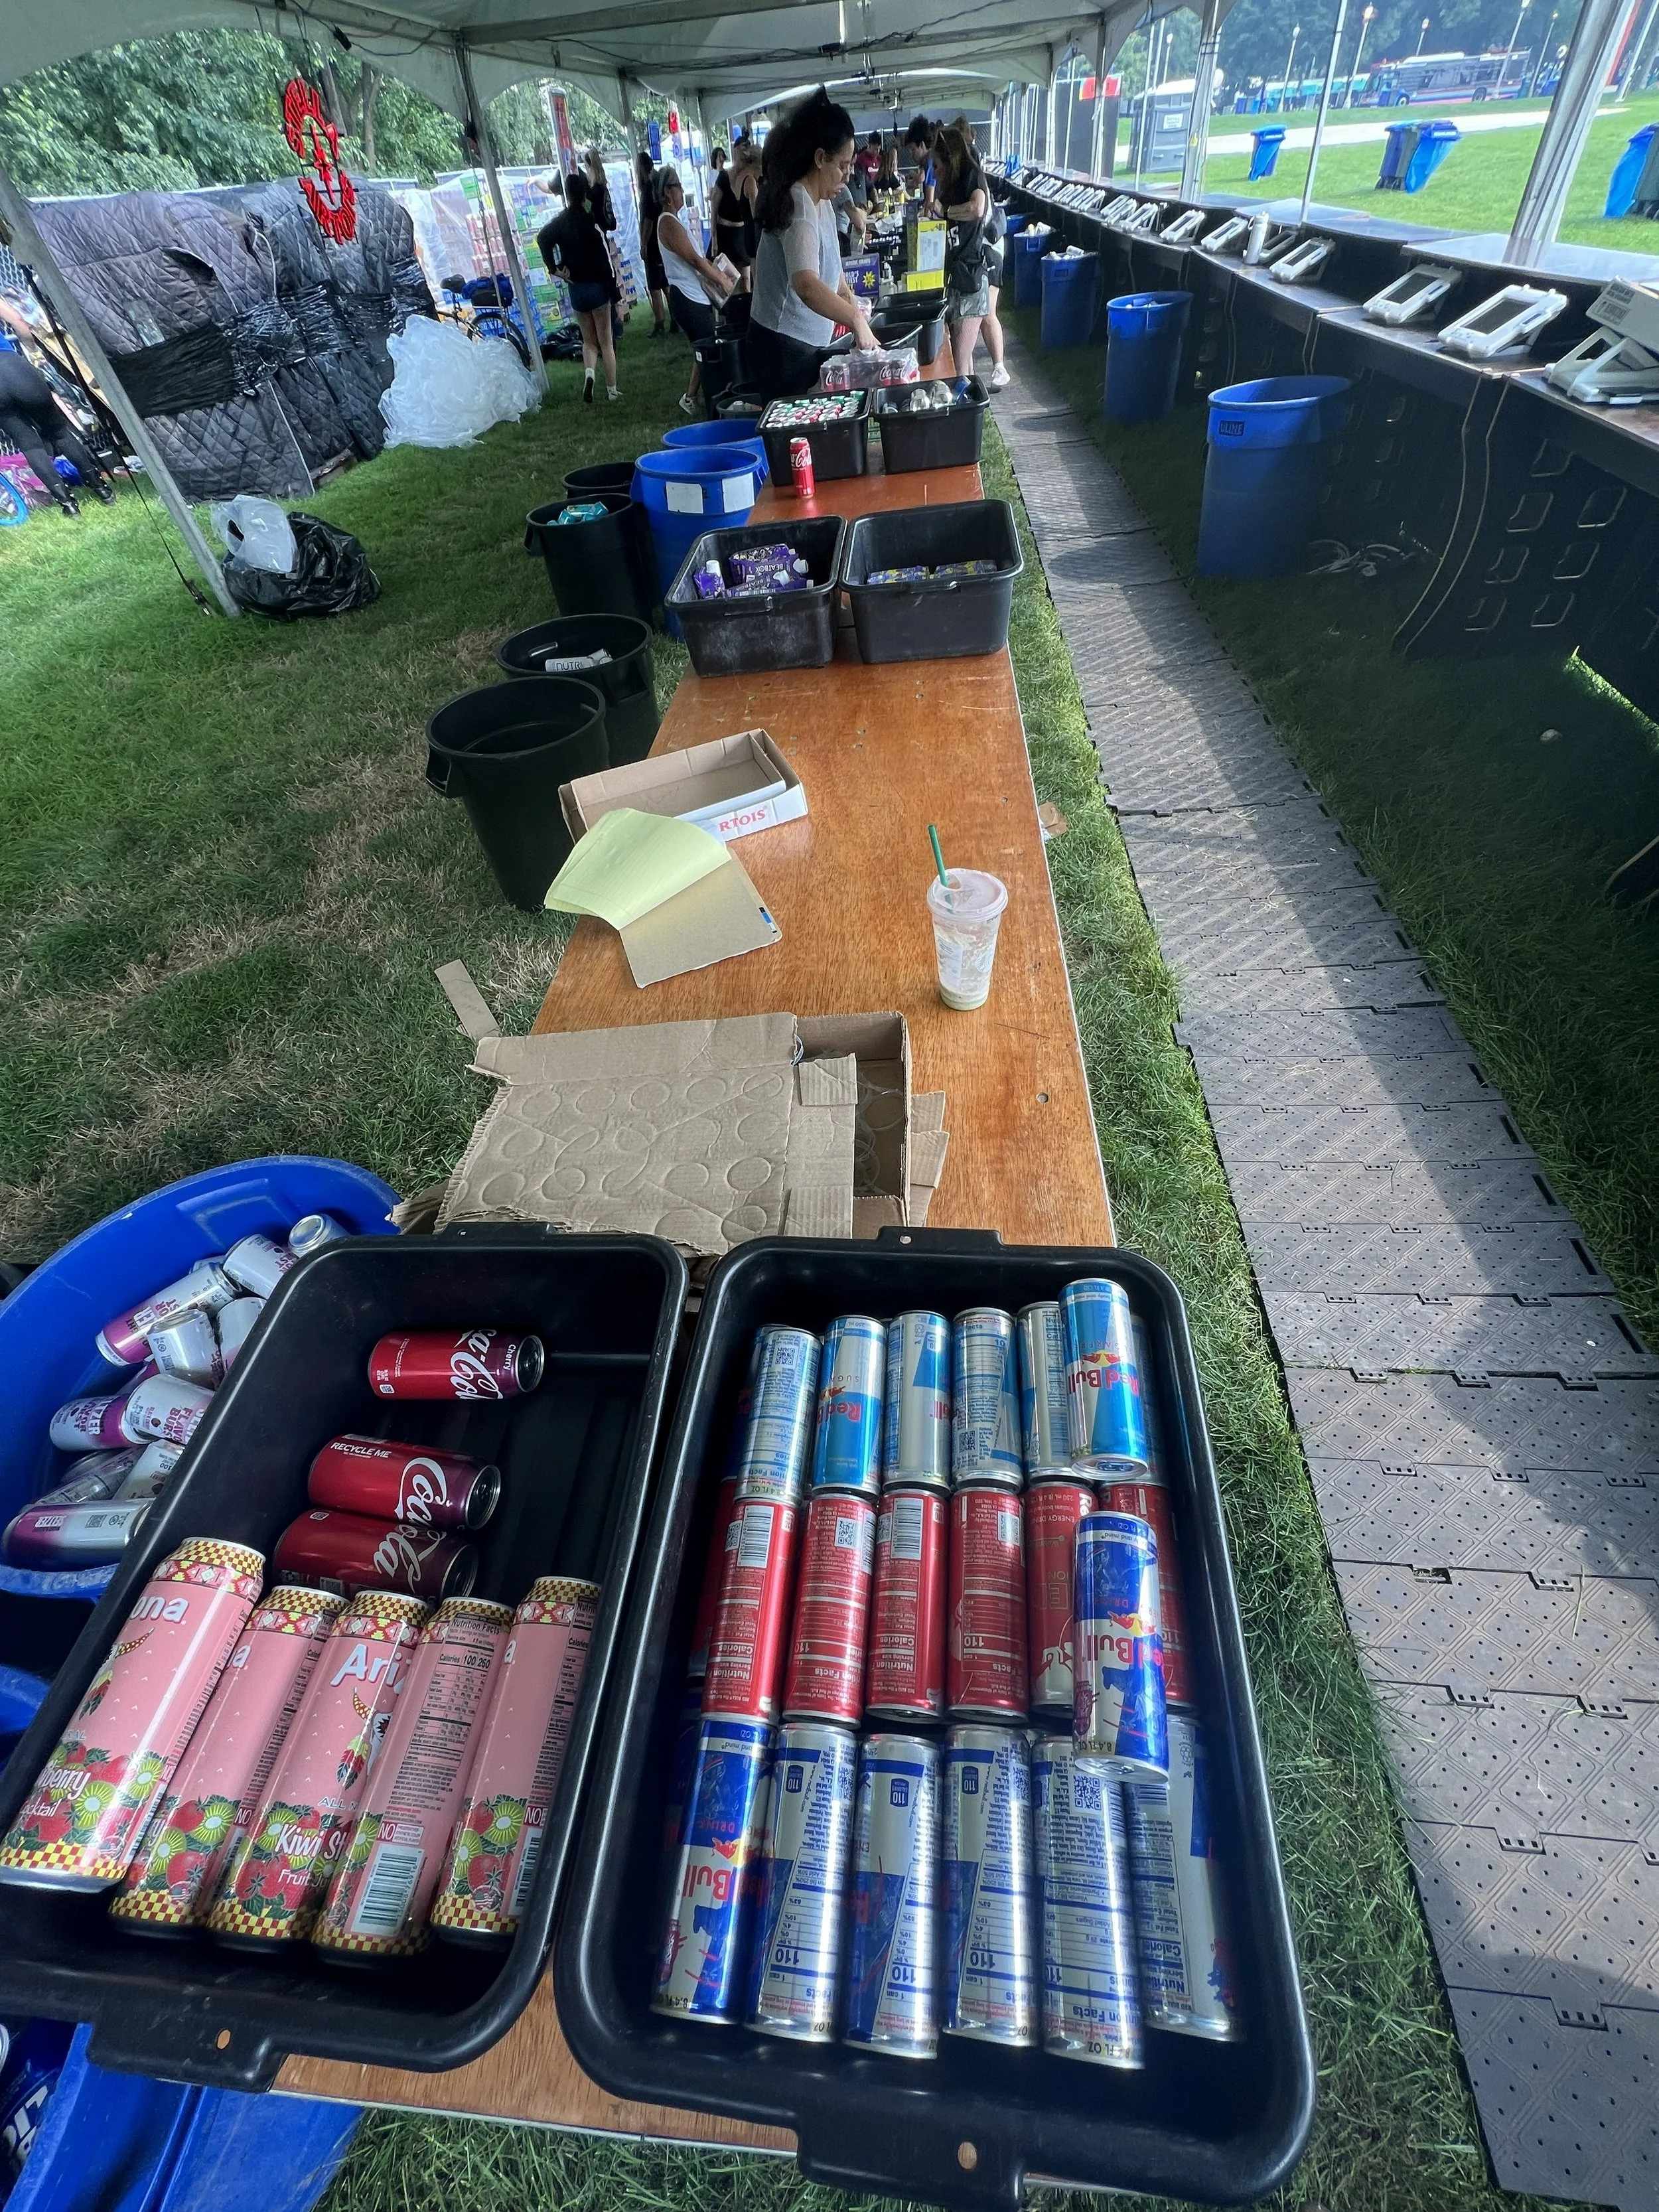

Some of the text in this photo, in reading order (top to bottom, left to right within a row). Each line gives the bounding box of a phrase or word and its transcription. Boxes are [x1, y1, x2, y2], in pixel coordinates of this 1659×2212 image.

[1220, 421, 1243, 435] ULINE
[755, 563, 784, 573] BEATBOX
[718, 810, 766, 832] RTOIS
[503, 1344, 516, 1370] Cherry
[1068, 1370, 1140, 1396] Red Bull
[827, 1401, 861, 1422] Red
[162, 1407, 178, 1439] BURS
[330, 1442, 375, 1456] RECYCLE
[374, 1450, 392, 1459] ME
[452, 1619, 500, 1635] Nutrition Facts
[880, 1636, 914, 1646] Calories
[964, 1636, 984, 1647] 110
[719, 1644, 753, 1654] Calories
[1087, 1635, 1133, 1664] Bull
[439, 1654, 490, 1669] Calories 100 260
[876, 1661, 914, 1671] Nutrition
[713, 1669, 751, 1680] Nutrition
[815, 1668, 839, 1679] Facts
[724, 1741, 740, 1750] mind
[1099, 1740, 1112, 1750] 8.4
[788, 1779, 799, 1790] 110
[964, 1780, 976, 1792] 110
[318, 1797, 346, 1810] ALL
[893, 1792, 906, 1804] 110
[235, 1808, 252, 1825] NO
[525, 1807, 541, 1825] NO
[378, 1822, 396, 1840] NO
[275, 1824, 324, 1857] Kiwi
[278, 1869, 312, 1885] Fruit
[682, 1864, 731, 1901] Bull
[1165, 1925, 1179, 1935] Total
[774, 1949, 799, 1964] 110
[1143, 1942, 1182, 1957] Calori
[970, 1952, 995, 1966] 110
[892, 1966, 916, 1983] 110
[1157, 1968, 1183, 1978] Serving
[1072, 2006, 1106, 2022] Facts
[1088, 2041, 1102, 2054] OZ
